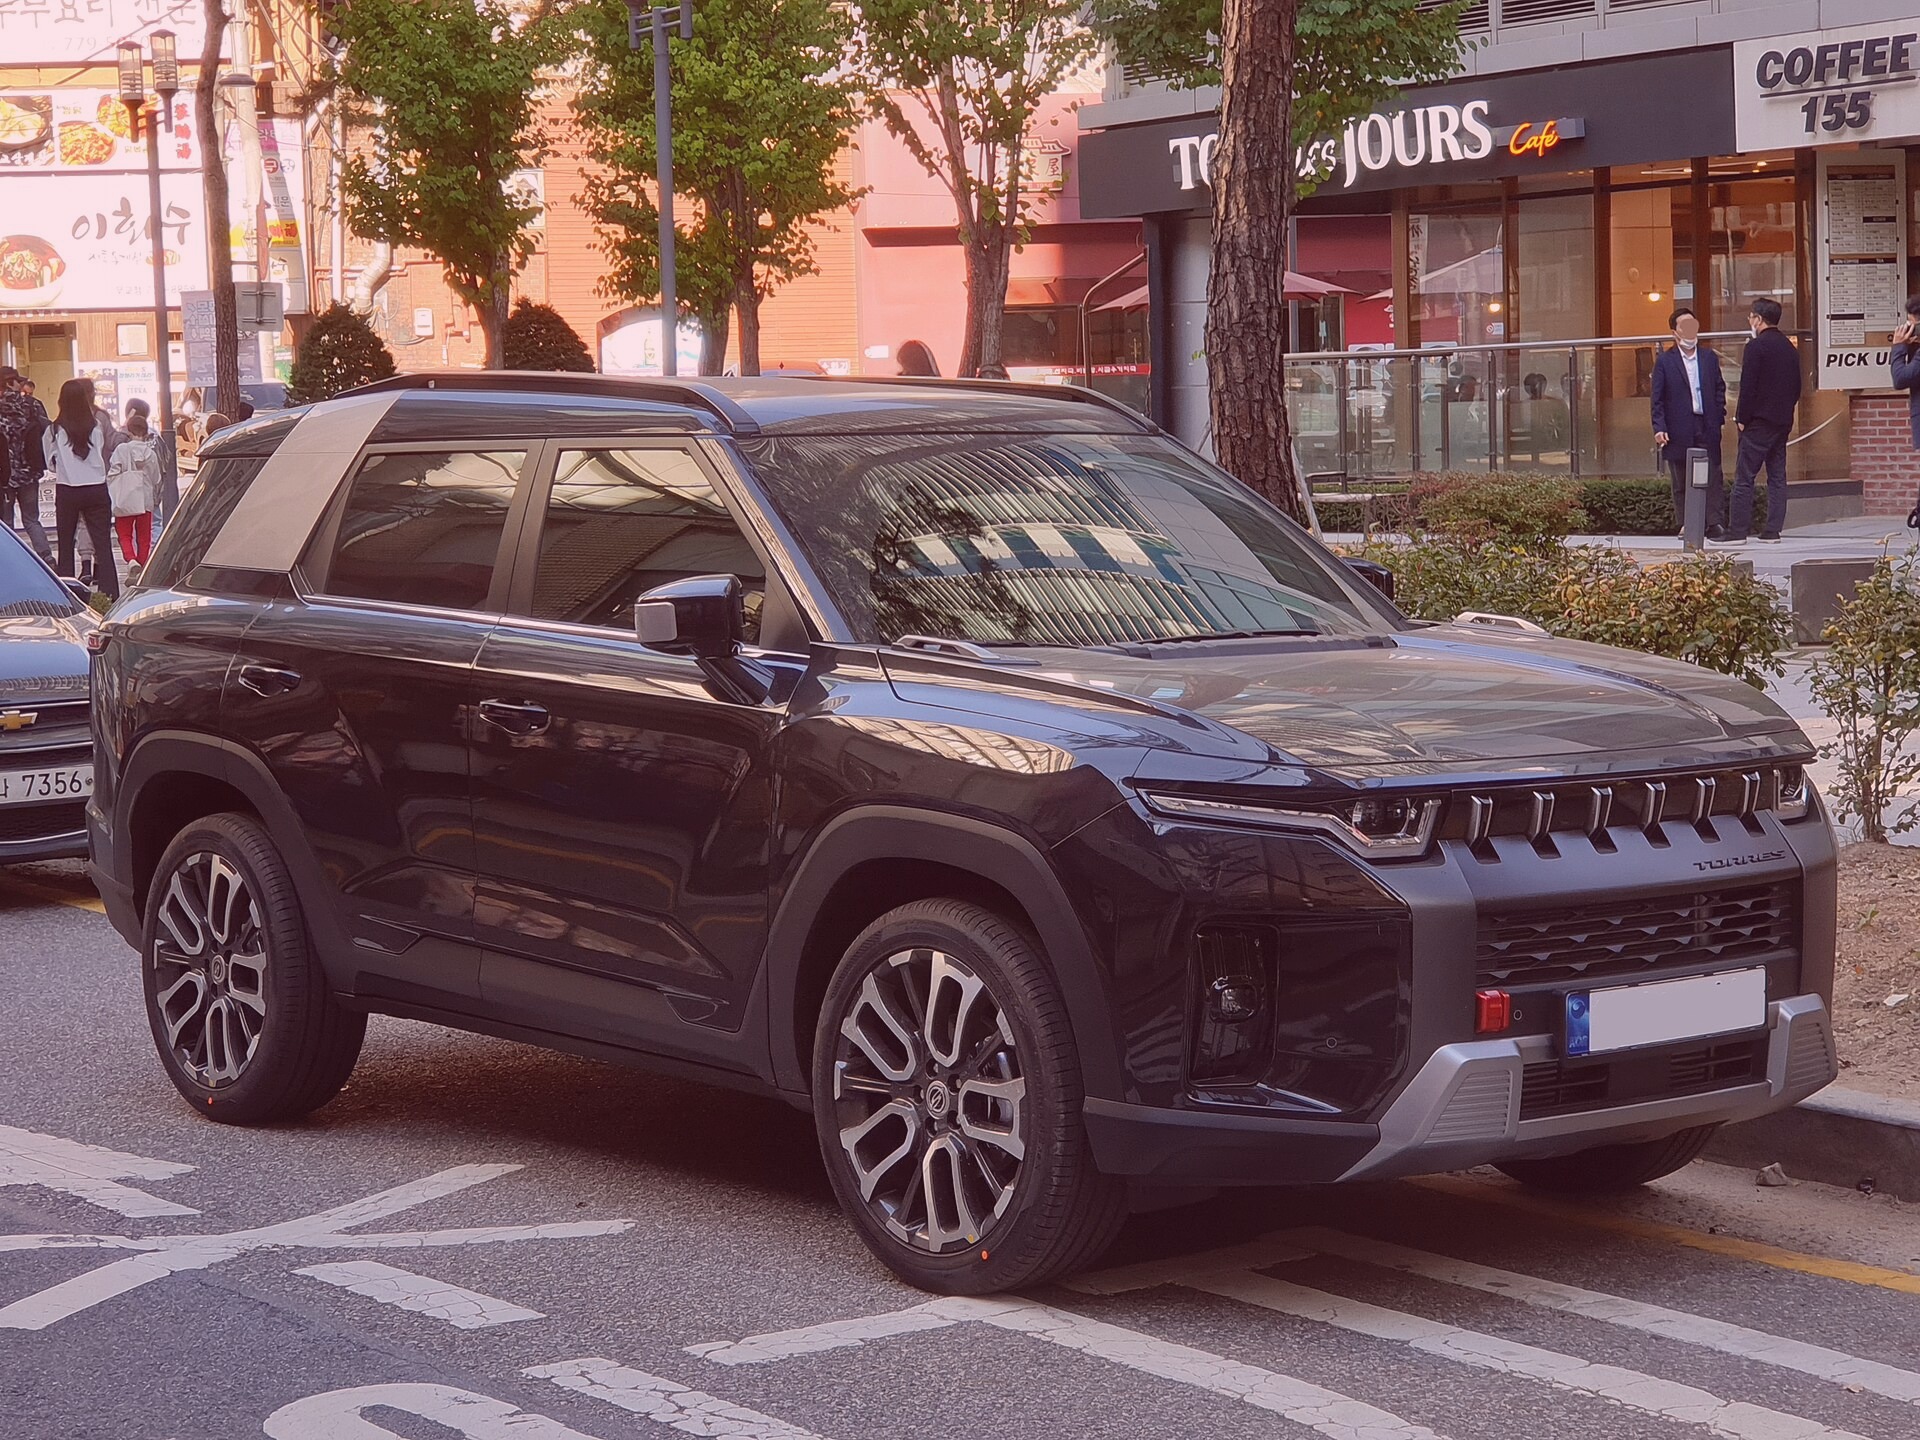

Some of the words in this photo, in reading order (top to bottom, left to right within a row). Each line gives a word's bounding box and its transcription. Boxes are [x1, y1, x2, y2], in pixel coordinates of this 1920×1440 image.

[1756, 33, 1918, 89] COFFEE
[1801, 91, 1871, 133] 155
[1343, 99, 1494, 188] JOURS
[1509, 120, 1559, 157] Café
[1826, 352, 1870, 368] PICK
[22, 770, 82, 797] 7356
[1693, 850, 1786, 871] TORRES
